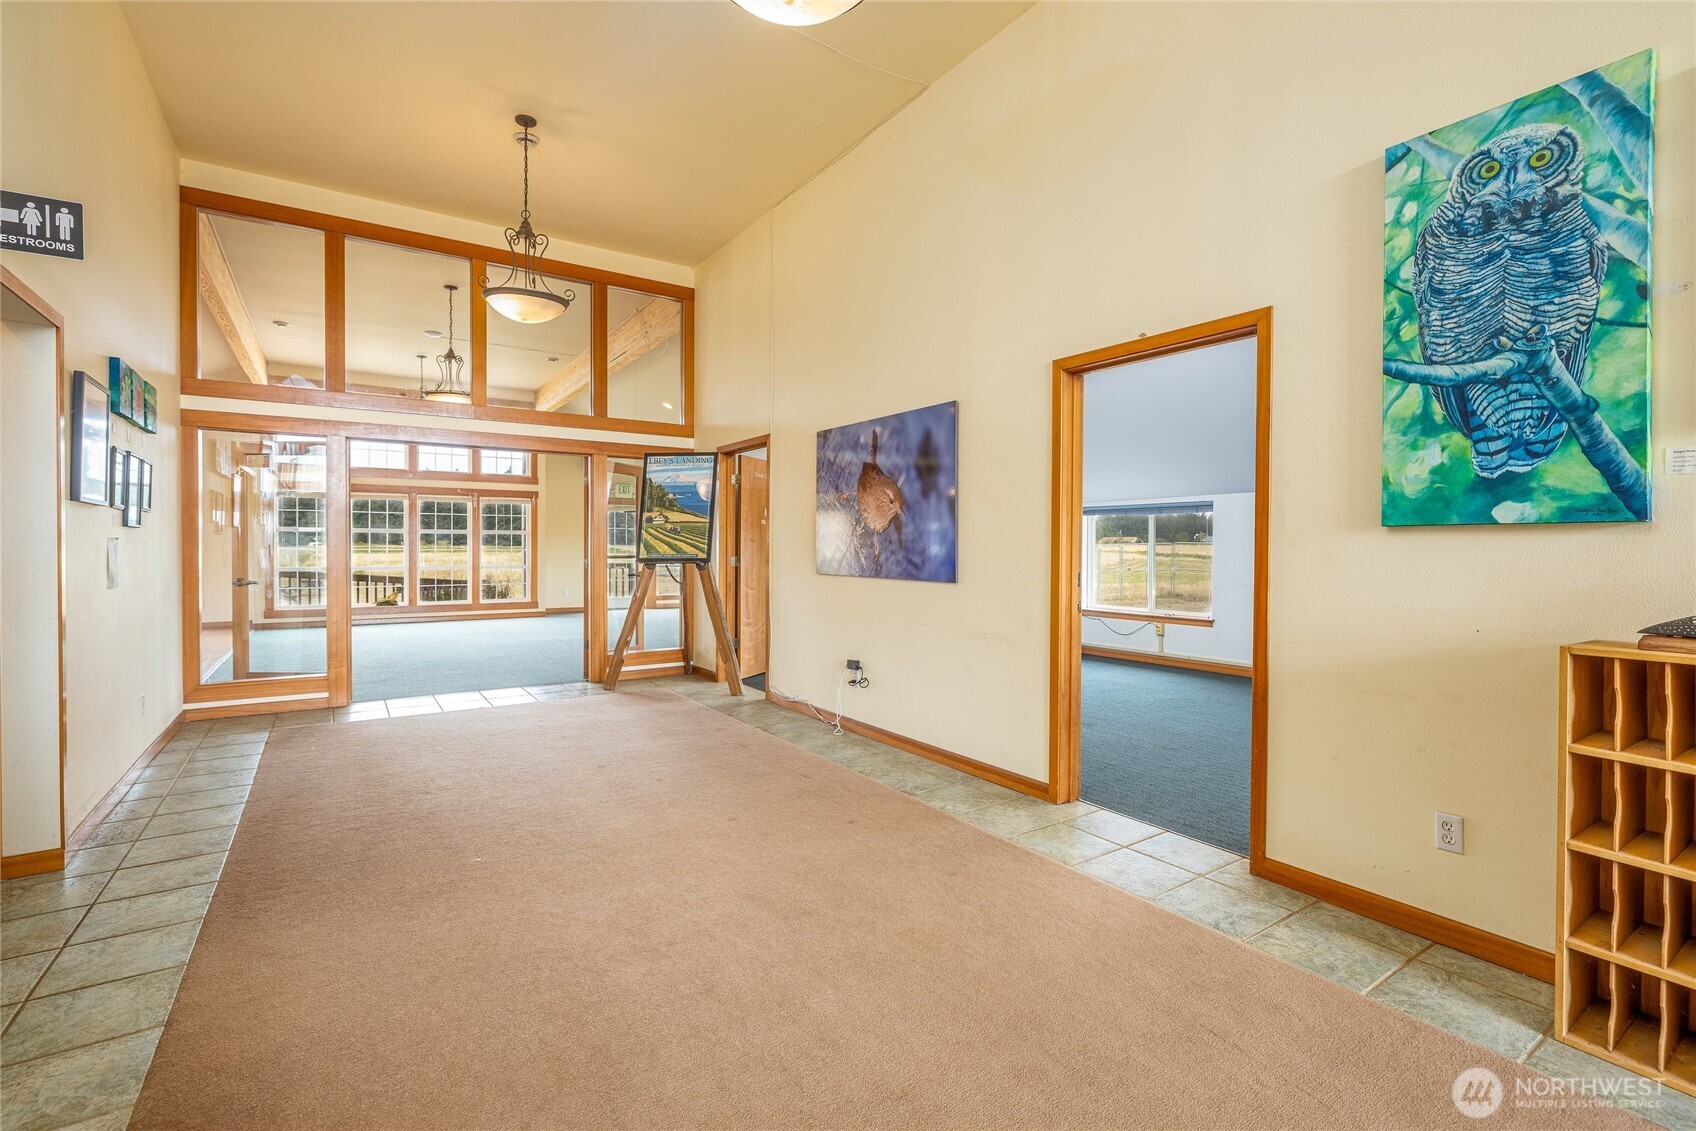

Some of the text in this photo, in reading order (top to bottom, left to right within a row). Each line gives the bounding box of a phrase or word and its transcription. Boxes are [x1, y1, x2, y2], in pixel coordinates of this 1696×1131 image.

[0, 234, 75, 252] ESTROOMS
[648, 456, 713, 465] EBEY'S LANDING
[618, 485, 631, 494] EXIT
